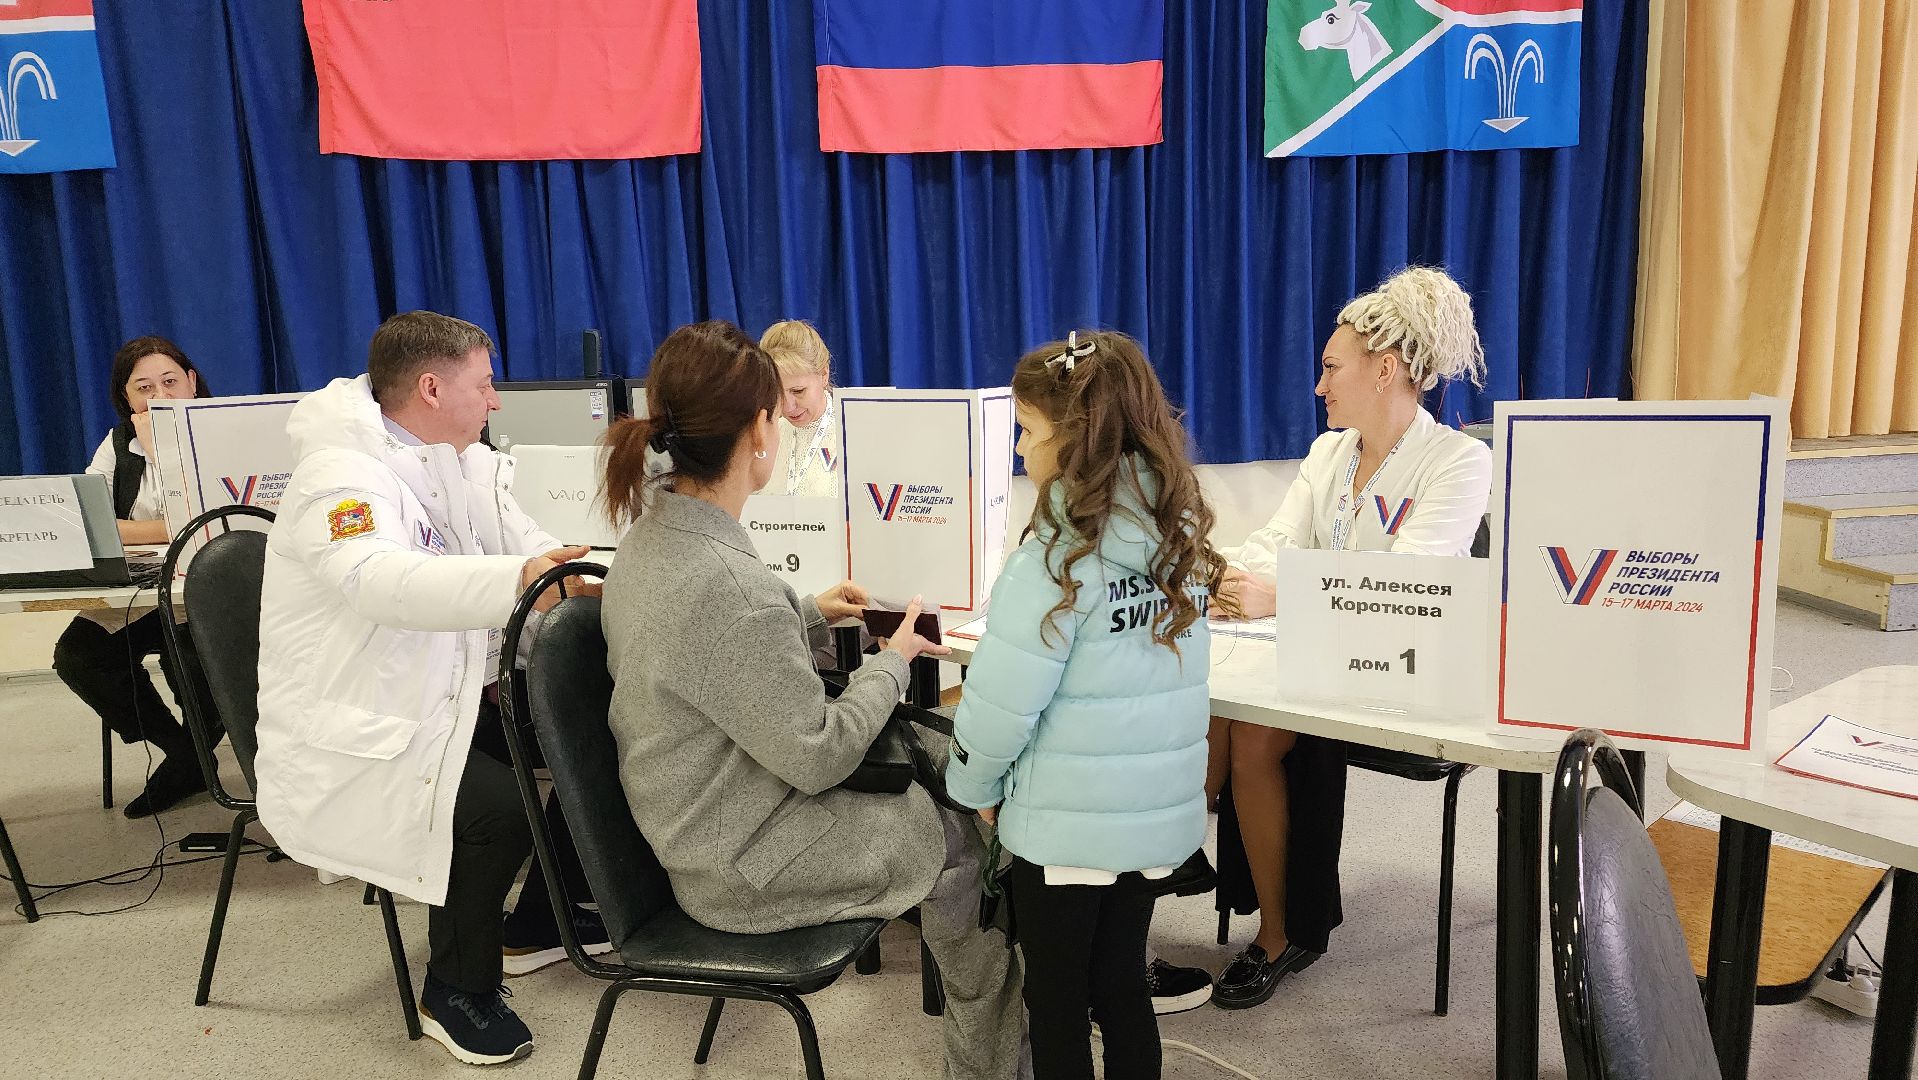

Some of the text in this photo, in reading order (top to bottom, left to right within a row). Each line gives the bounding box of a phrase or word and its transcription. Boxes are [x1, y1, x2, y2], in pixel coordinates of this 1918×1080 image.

[256, 491, 285, 499] РОССИ
[548, 489, 586, 502] VAIO
[906, 484, 944, 494] ВЫБОРЫ
[903, 495, 954, 505] ПРЕЗИДЕНТА
[900, 505, 932, 515] РОССИИ
[749, 520, 826, 533] Строителей
[913, 516, 933, 524] МАРТА
[765, 553, 800, 573] ом 9
[1625, 550, 1699, 566] ВЫБОРЫ
[1616, 566, 1721, 584] ПРЕЗИДЕНТА
[1321, 576, 1452, 597] ул. Алексея
[1607, 582, 1674, 597] РОССИИ
[1331, 596, 1442, 618] Короткова
[1633, 599, 1672, 612] МАРТА
[1673, 601, 1704, 613] 2024
[1348, 648, 1416, 675] дом 1
